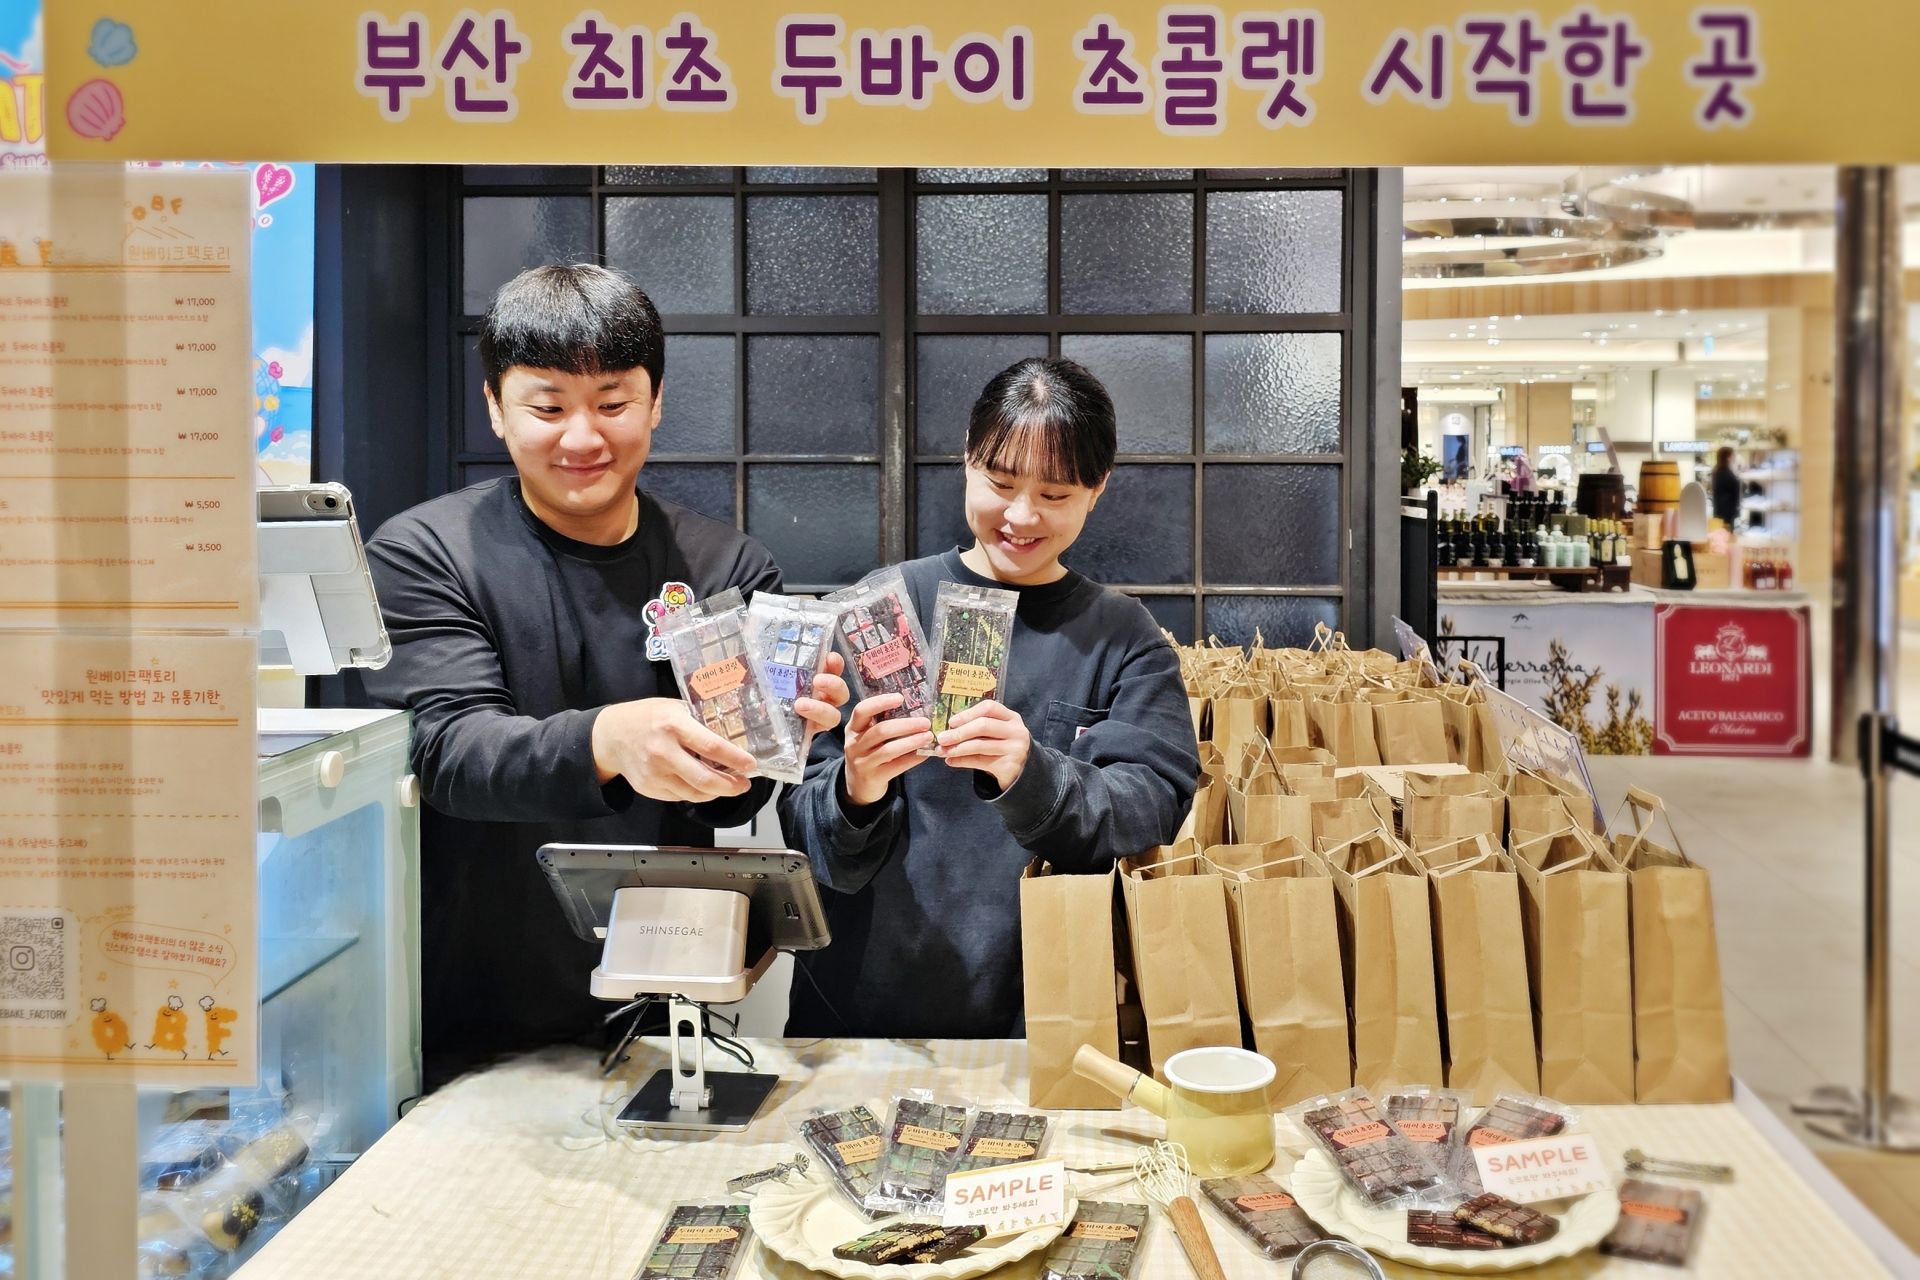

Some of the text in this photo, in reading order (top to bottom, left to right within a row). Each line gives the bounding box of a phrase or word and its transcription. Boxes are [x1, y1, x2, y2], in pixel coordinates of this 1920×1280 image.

[363, 12, 1758, 126] 부산 최초 두바이 초콜렛 시작한 곳
[187, 298, 216, 308] 17,000
[188, 343, 217, 353] 17,000
[189, 388, 218, 398] 17,000
[190, 432, 219, 442] 17,000
[196, 501, 221, 511] 5,500
[197, 543, 222, 553] 3,500
[1689, 661, 1773, 675] LEONARDI
[86, 669, 177, 685] 원베이크팩토리
[41, 689, 221, 706] 맛있게 먹는 방법 과 유통기한
[1678, 710, 1785, 722] ACETO BALSAMICO
[639, 925, 705, 938] SHINSEGAE
[1487, 1146, 1590, 1173] SAMPLE
[954, 1174, 1054, 1206] SAMPLE
[968, 1205, 999, 1219] 눈으로만
